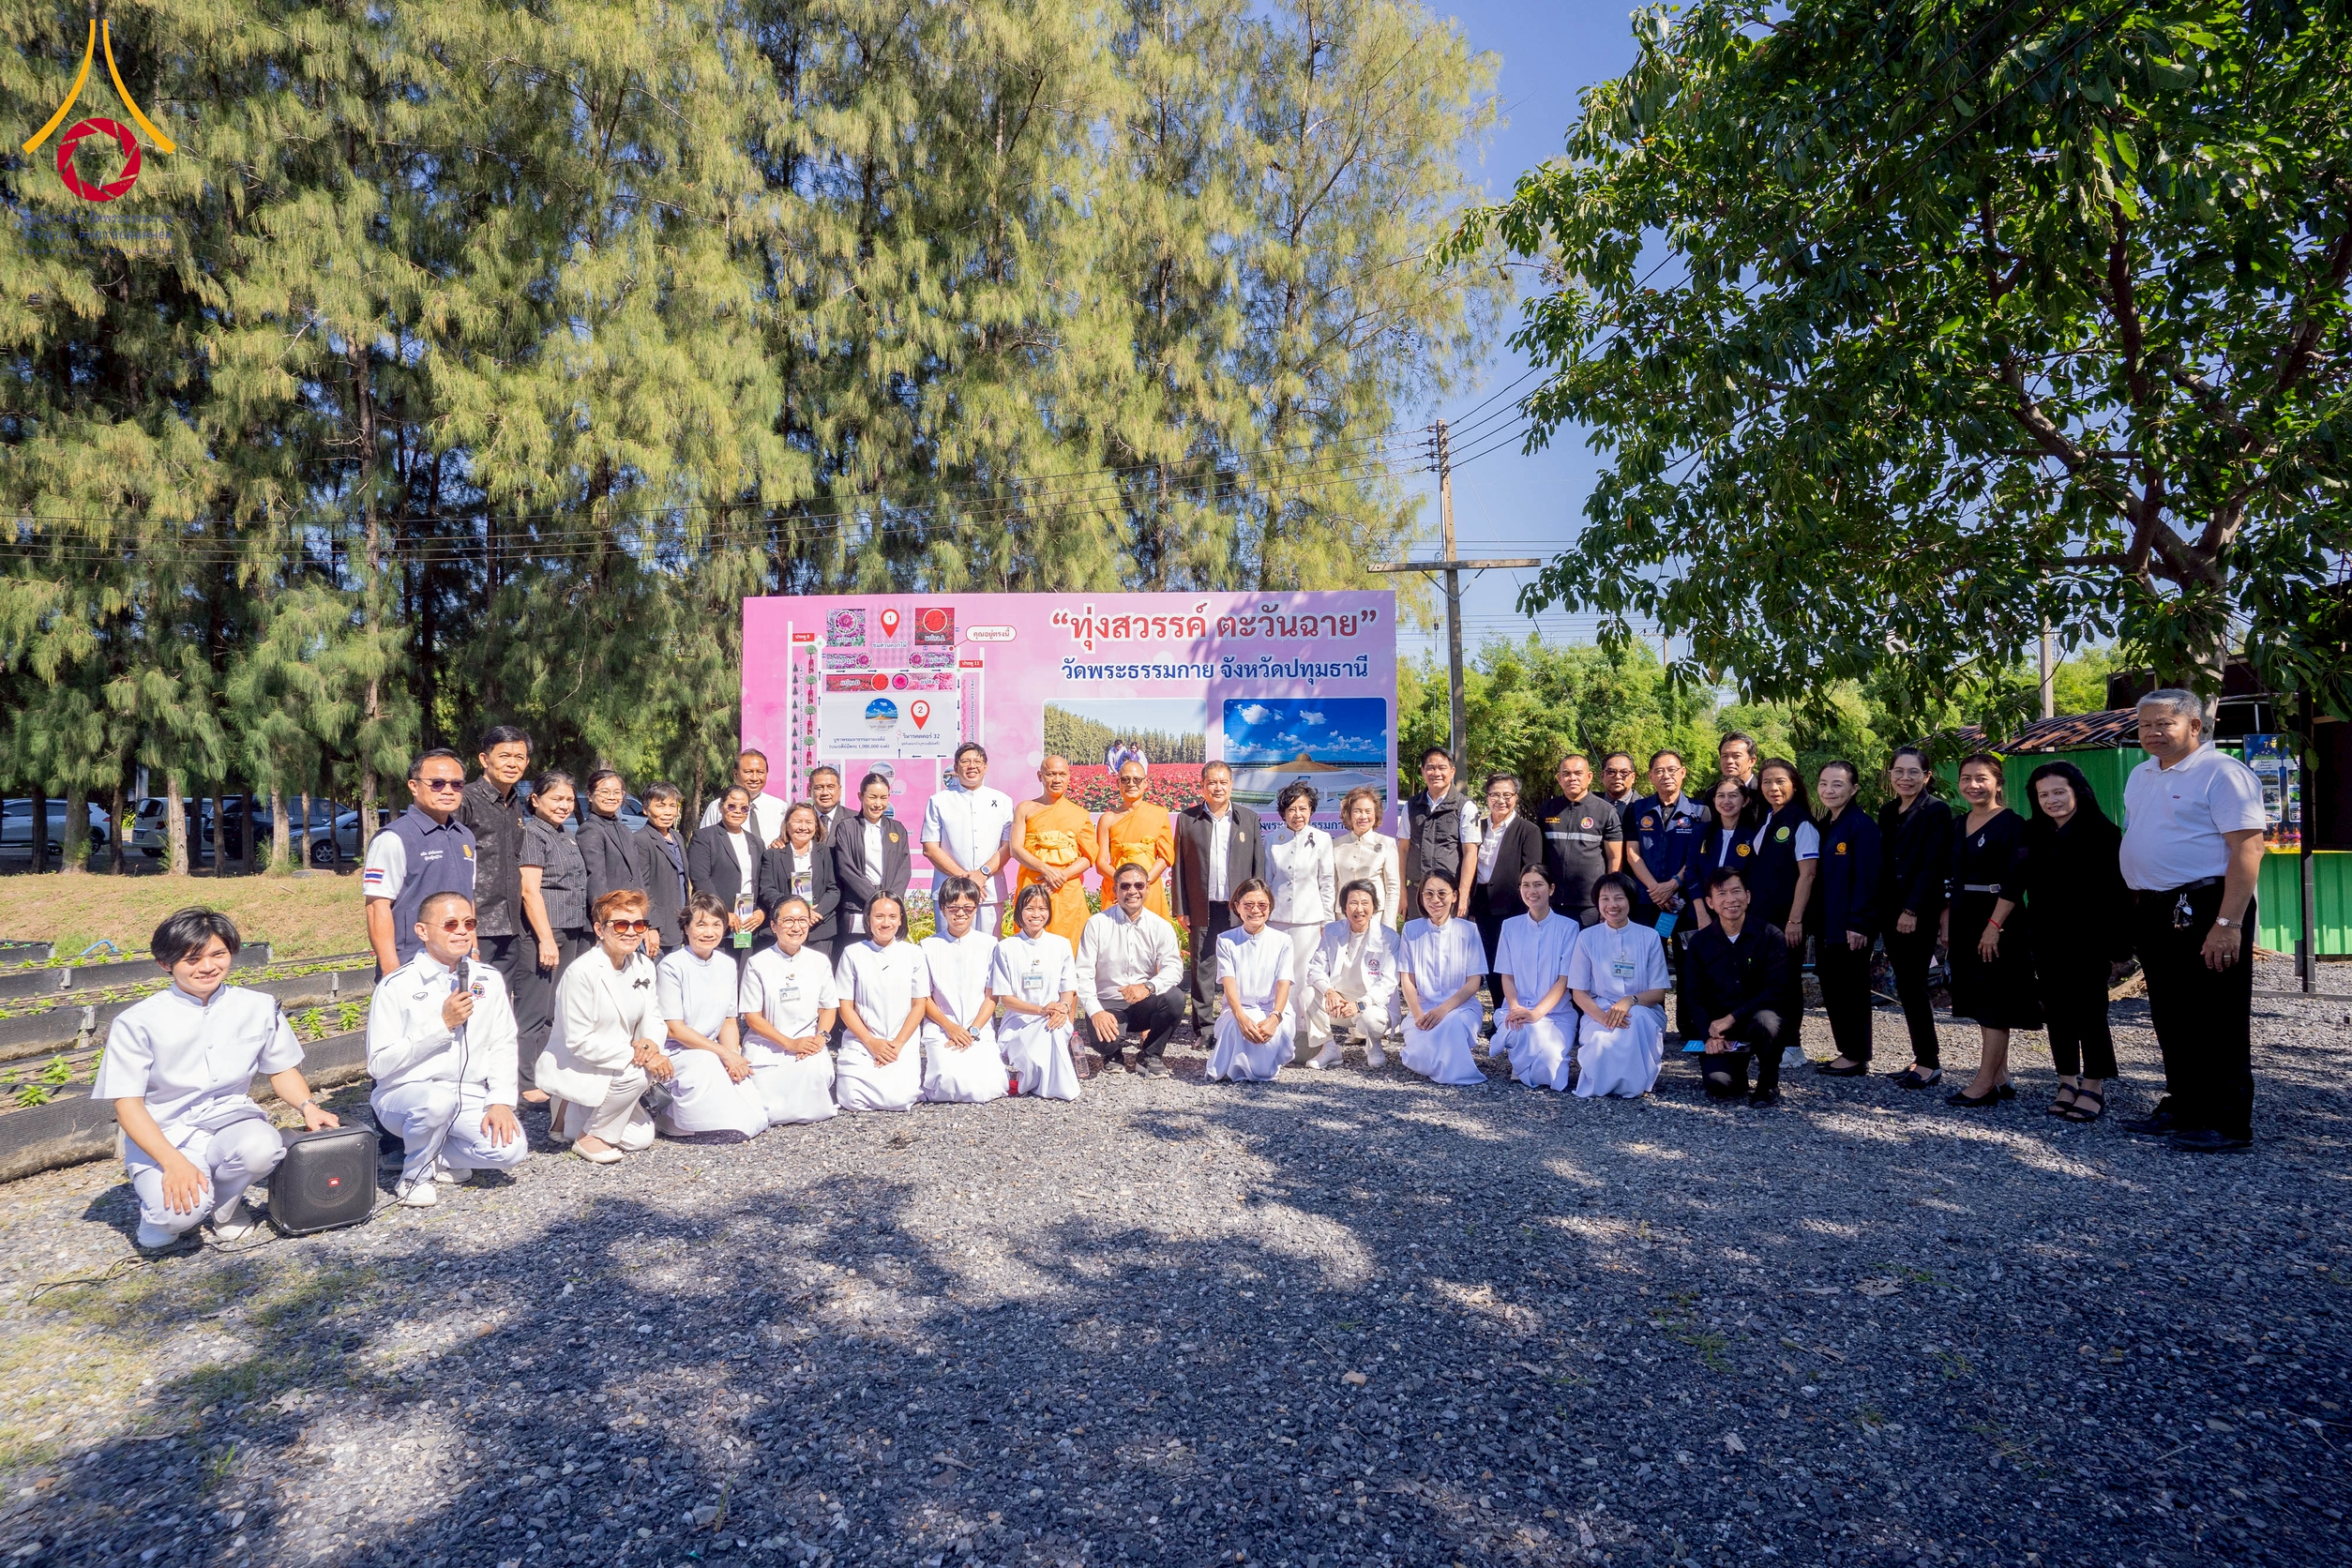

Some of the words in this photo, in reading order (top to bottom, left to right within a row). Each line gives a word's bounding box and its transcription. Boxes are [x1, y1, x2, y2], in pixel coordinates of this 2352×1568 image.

[972, 626, 1011, 641] คุณอยู่ตรงนี้
[1052, 602, 1207, 651] “ทุ่งสวรรค์
[1218, 603, 1378, 639] ตะวันฉาย”
[1062, 656, 1214, 680] วัดพระธรรมกาย
[1221, 655, 1368, 686] จังหวัดปทุมธานี
[917, 705, 924, 714] 2
